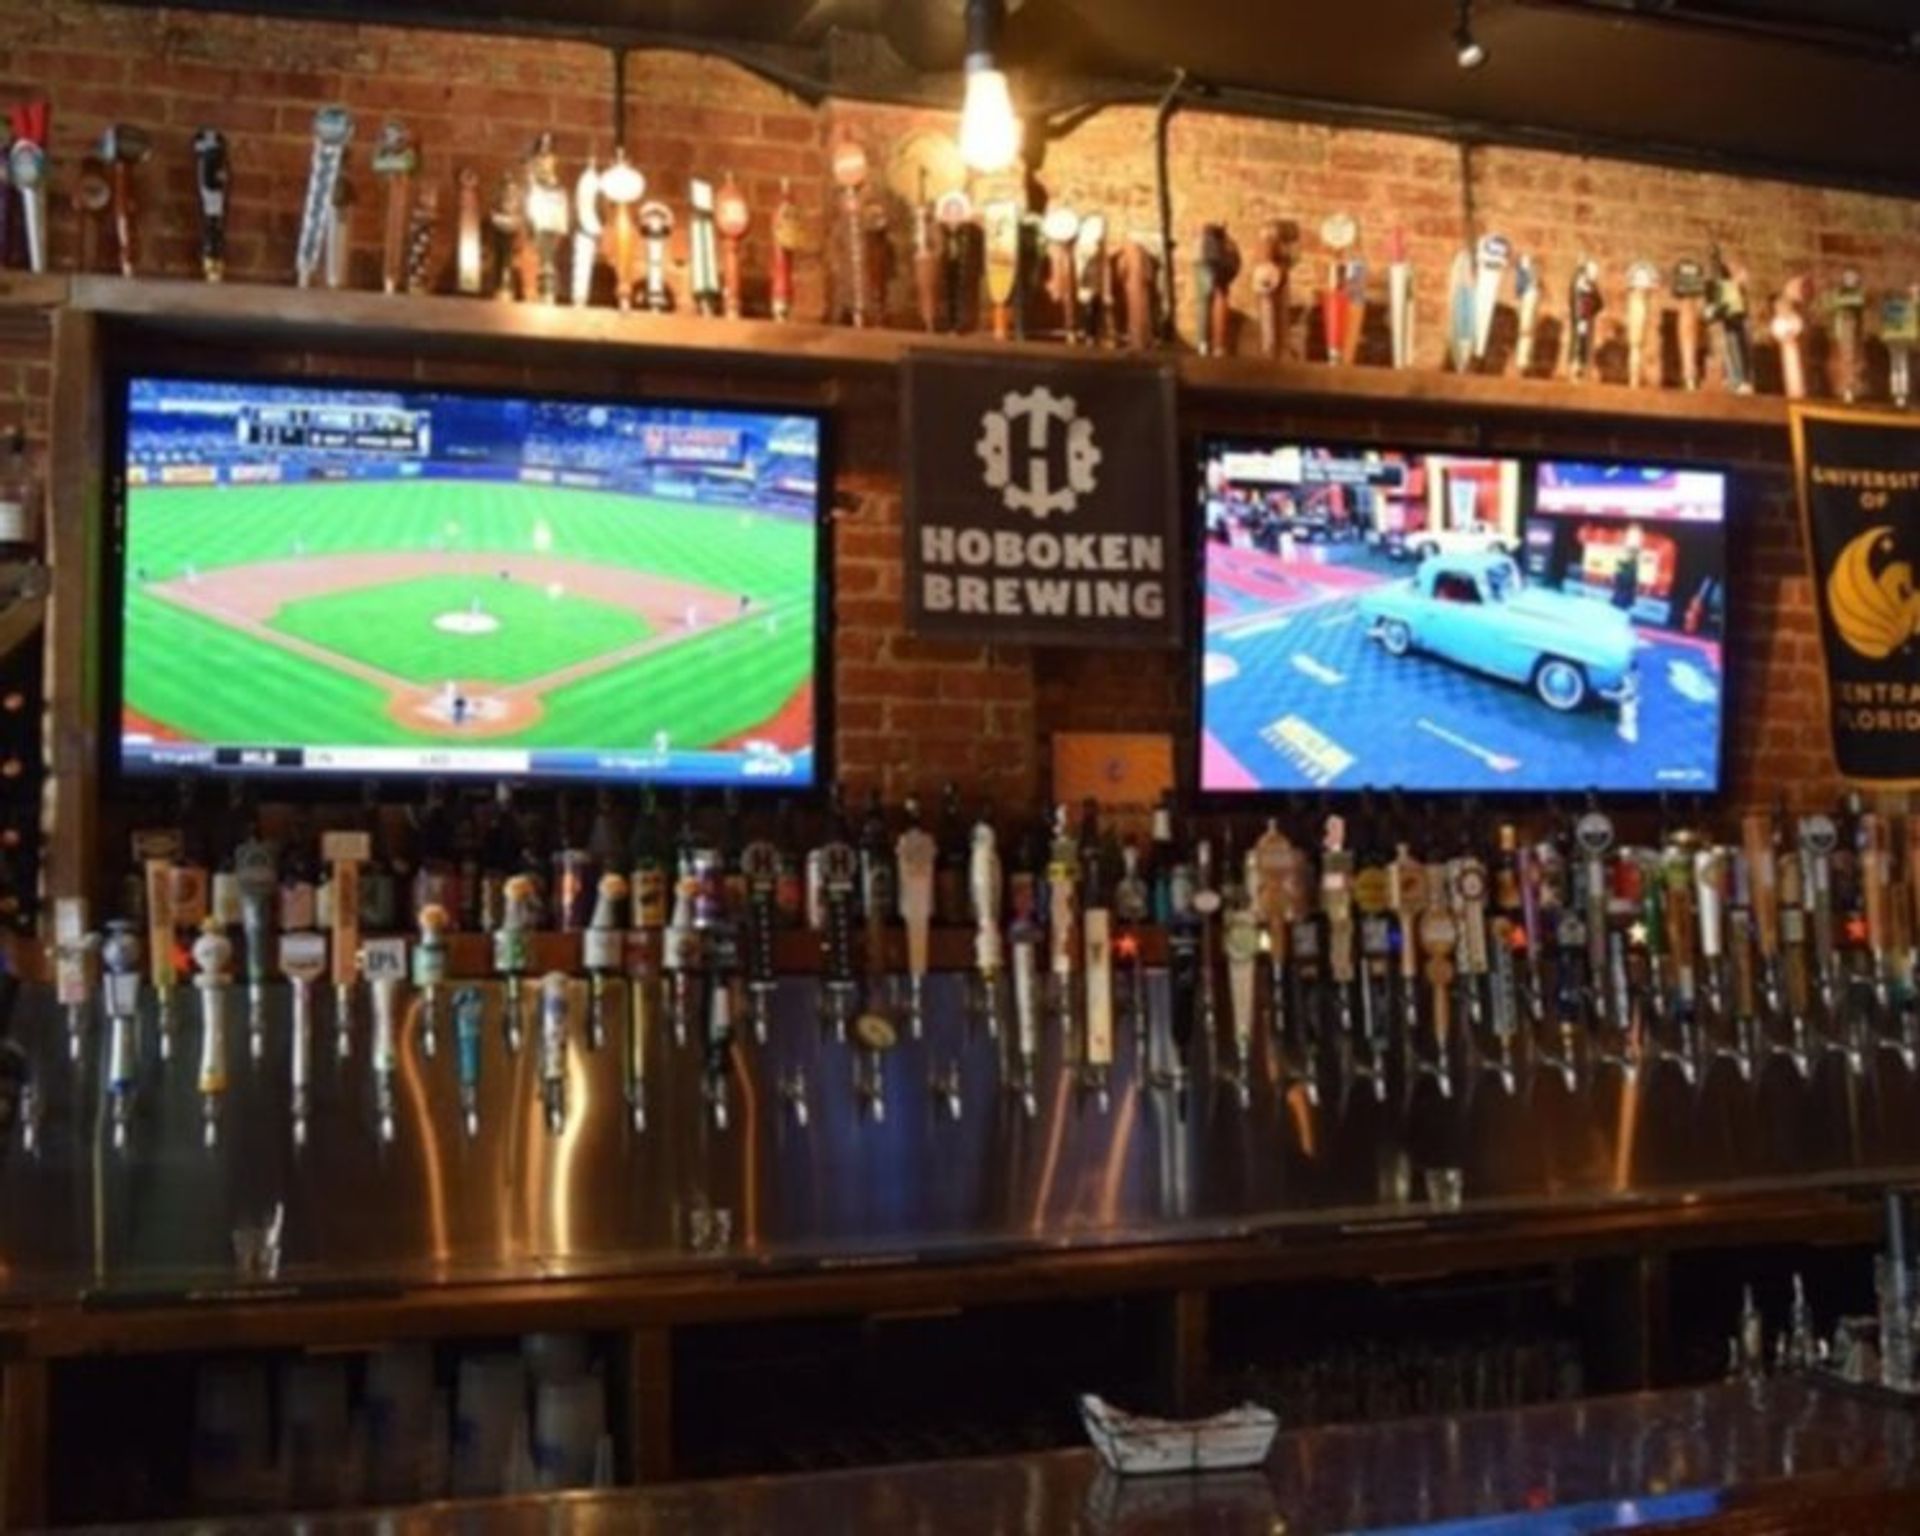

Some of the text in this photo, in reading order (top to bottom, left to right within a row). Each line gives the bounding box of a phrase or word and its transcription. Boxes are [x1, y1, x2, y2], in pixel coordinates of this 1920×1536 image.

[1860, 491, 1888, 511] OF
[921, 525, 1163, 571] HOBOKEN
[923, 573, 1164, 618] BREWING
